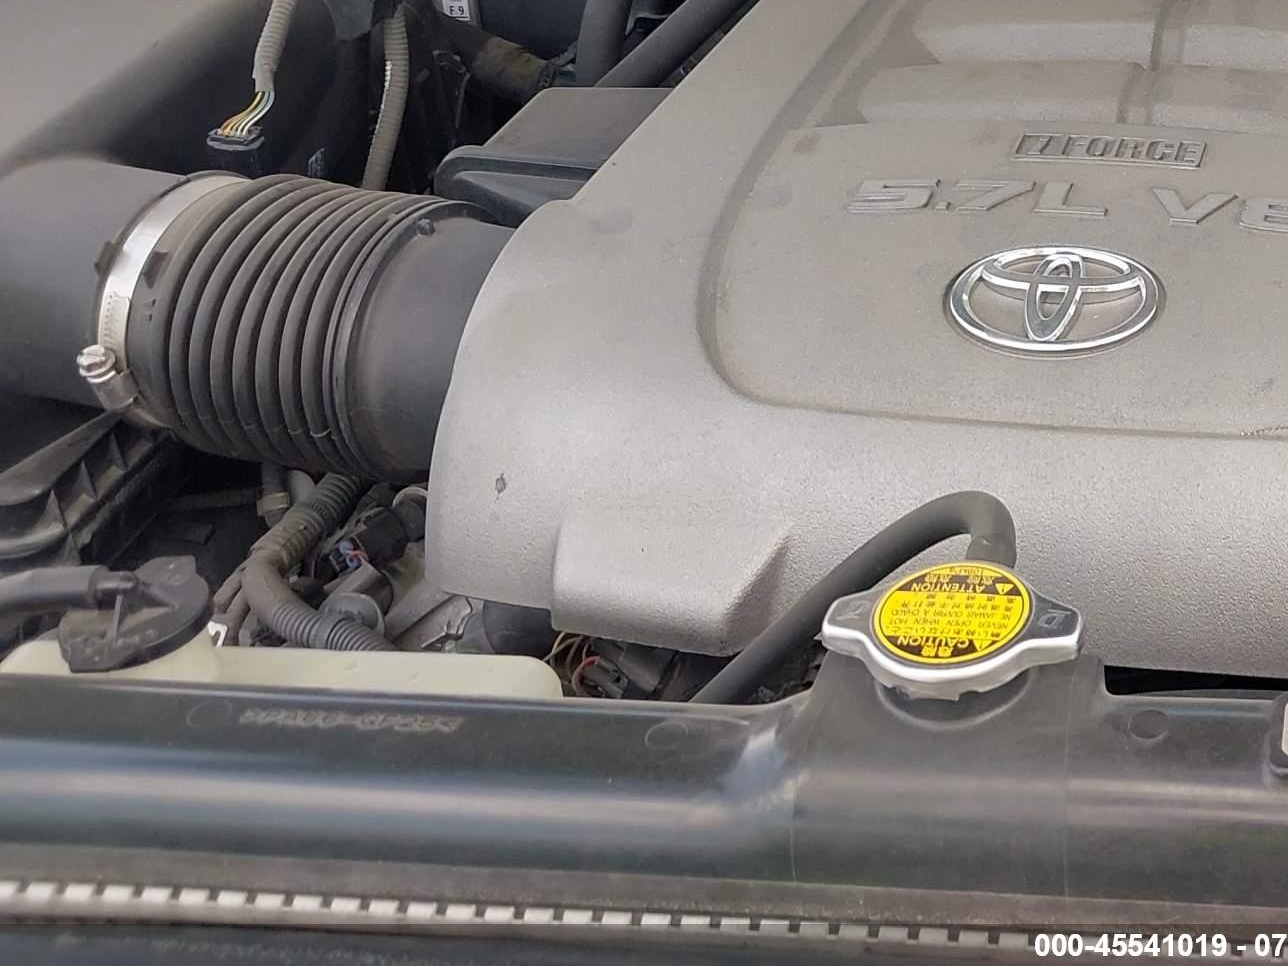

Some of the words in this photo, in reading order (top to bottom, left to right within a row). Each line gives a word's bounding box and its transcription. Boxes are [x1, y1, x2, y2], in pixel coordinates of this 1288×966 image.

[847, 179, 1109, 218] 5.7L
[911, 583, 985, 593] ATTENTION
[914, 618, 940, 626] WHEN
[948, 619, 972, 627] OPEN
[978, 621, 1009, 630] NEVER
[897, 636, 970, 649] CAUTION
